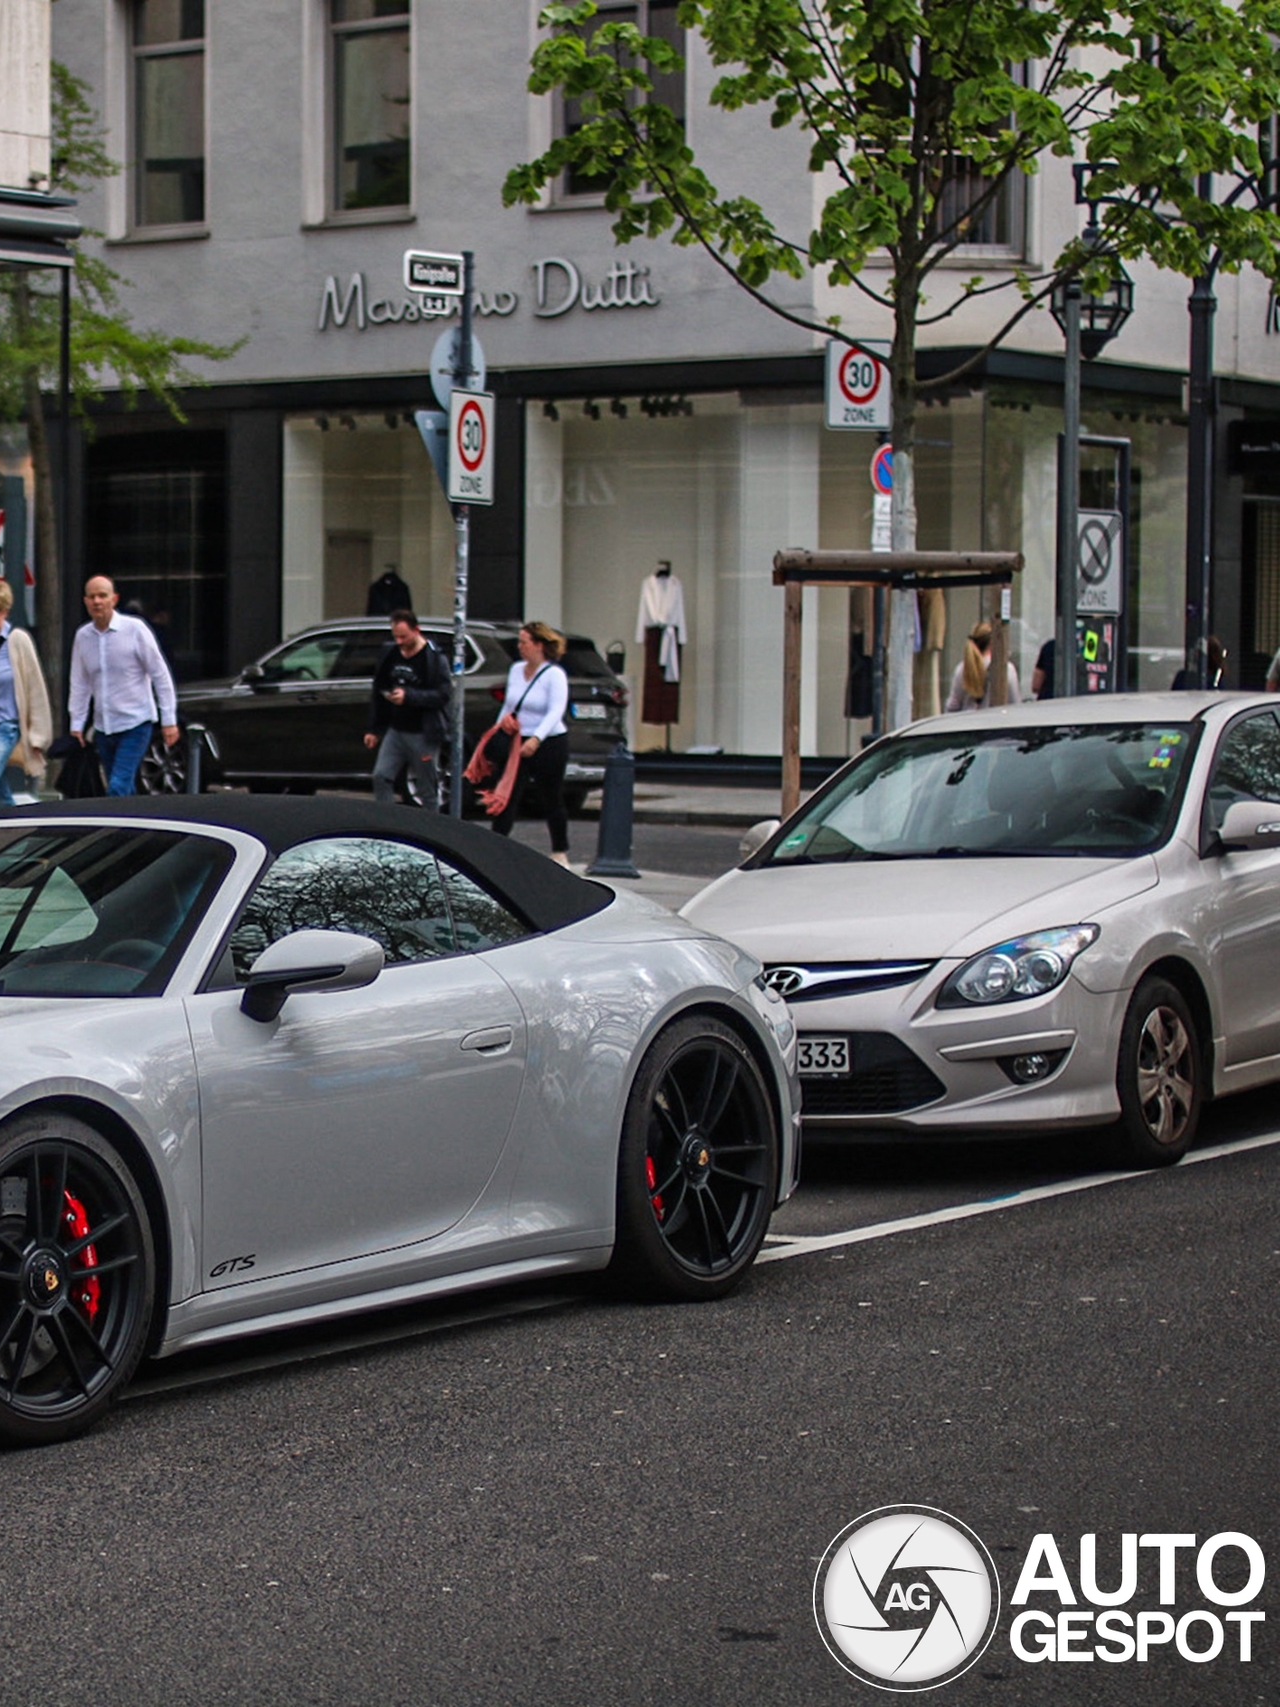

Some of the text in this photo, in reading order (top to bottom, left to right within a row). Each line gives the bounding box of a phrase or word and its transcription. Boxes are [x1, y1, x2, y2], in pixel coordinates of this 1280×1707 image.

[531, 257, 661, 318] Dutti
[847, 361, 873, 389] 30
[843, 407, 876, 423] ZONE
[463, 418, 480, 452] 30
[460, 474, 483, 495] ZONE
[799, 1042, 846, 1068] 333
[209, 1253, 257, 1278] GTS
